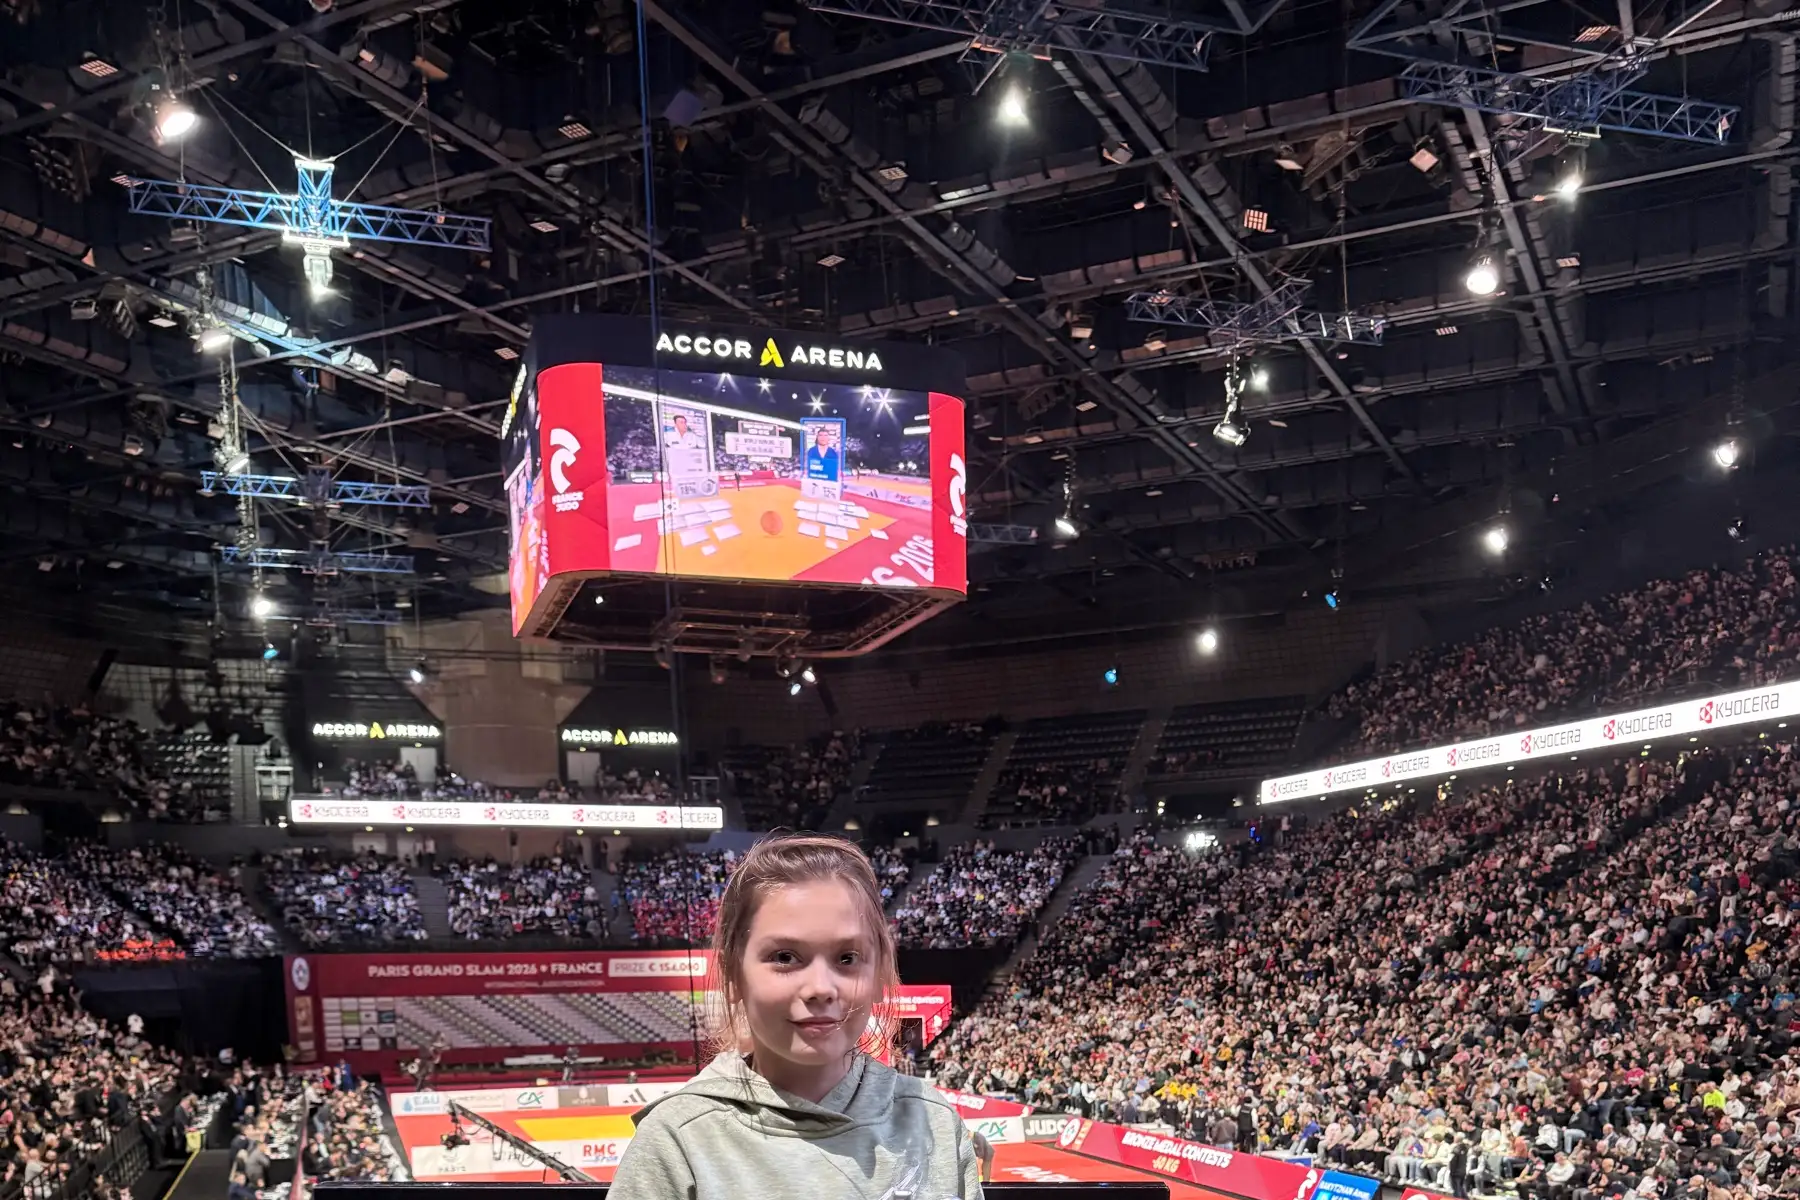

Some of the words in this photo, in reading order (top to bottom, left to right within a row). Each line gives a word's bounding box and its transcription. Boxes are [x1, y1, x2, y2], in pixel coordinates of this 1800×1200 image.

[656, 333, 752, 359] ACCOR
[791, 345, 883, 370] ARENA
[312, 723, 368, 736] ACCOR
[386, 723, 441, 737] ARENA
[561, 729, 613, 742] ACCOR
[628, 731, 678, 745] ARENA
[368, 964, 410, 977] PARIS
[412, 963, 464, 976] GRAND
[466, 963, 504, 976] SLAM
[507, 963, 537, 976] 2026
[551, 962, 603, 975] FRANCE
[614, 963, 645, 973] PRIZE
[583, 1143, 616, 1157] RMC
[1122, 1131, 1156, 1150] BRONZE
[1152, 1138, 1183, 1157] MEDAL
[1182, 1144, 1233, 1169] CONTESTS
